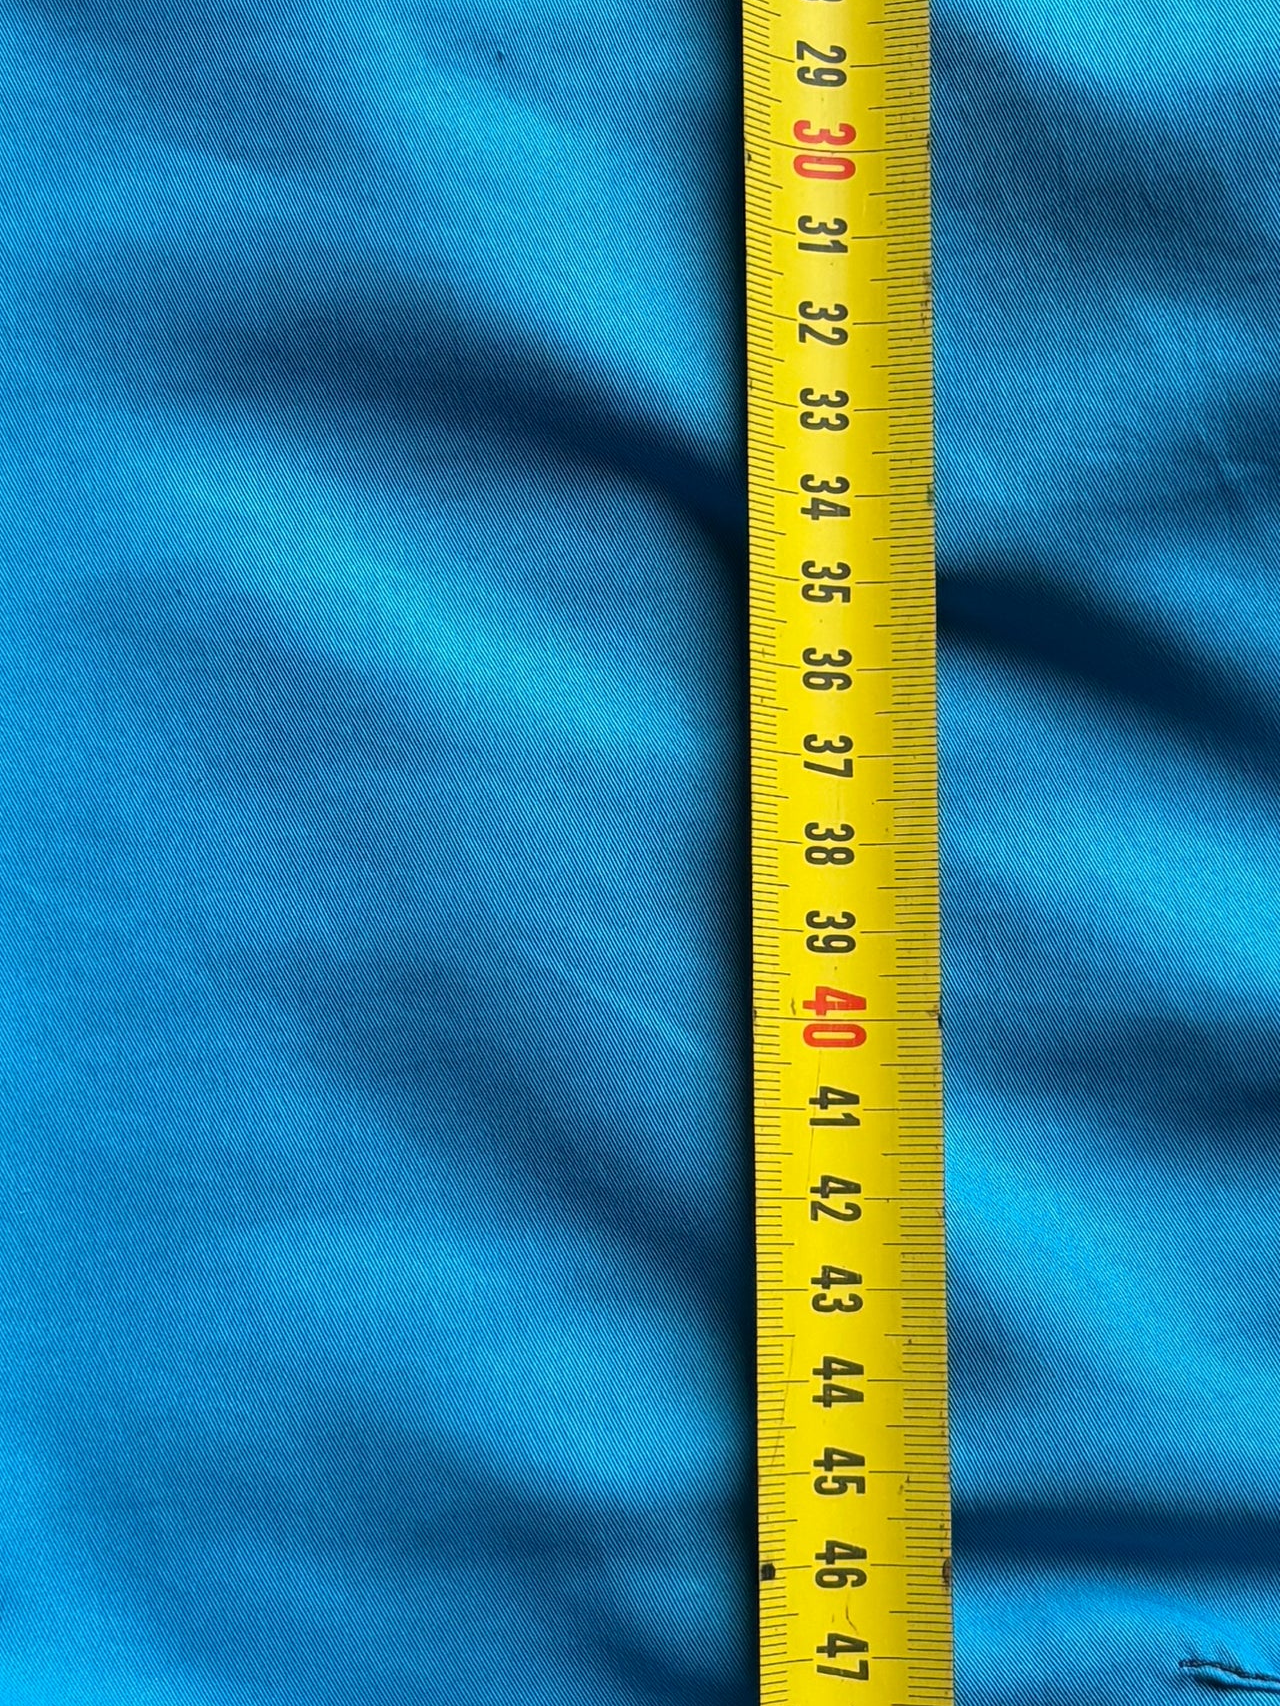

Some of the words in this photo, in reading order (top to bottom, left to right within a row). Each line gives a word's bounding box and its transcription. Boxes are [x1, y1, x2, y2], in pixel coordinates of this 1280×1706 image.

[796, 40, 847, 87] 29
[792, 120, 856, 181] 30
[797, 215, 848, 254] 31
[798, 300, 849, 346] 32
[799, 387, 850, 432] 33
[800, 474, 851, 521] 34
[801, 560, 851, 603] 35
[802, 647, 852, 691] 36
[803, 734, 854, 778] 37
[804, 822, 855, 866] 38
[805, 910, 856, 954] 39
[802, 986, 867, 1049] 40
[808, 1086, 861, 1127] 41
[810, 1175, 862, 1222] 42
[810, 1265, 863, 1313] 43
[812, 1356, 865, 1408] 44
[813, 1447, 866, 1496] 45
[815, 1540, 868, 1589] 46
[816, 1633, 870, 1681] 47
